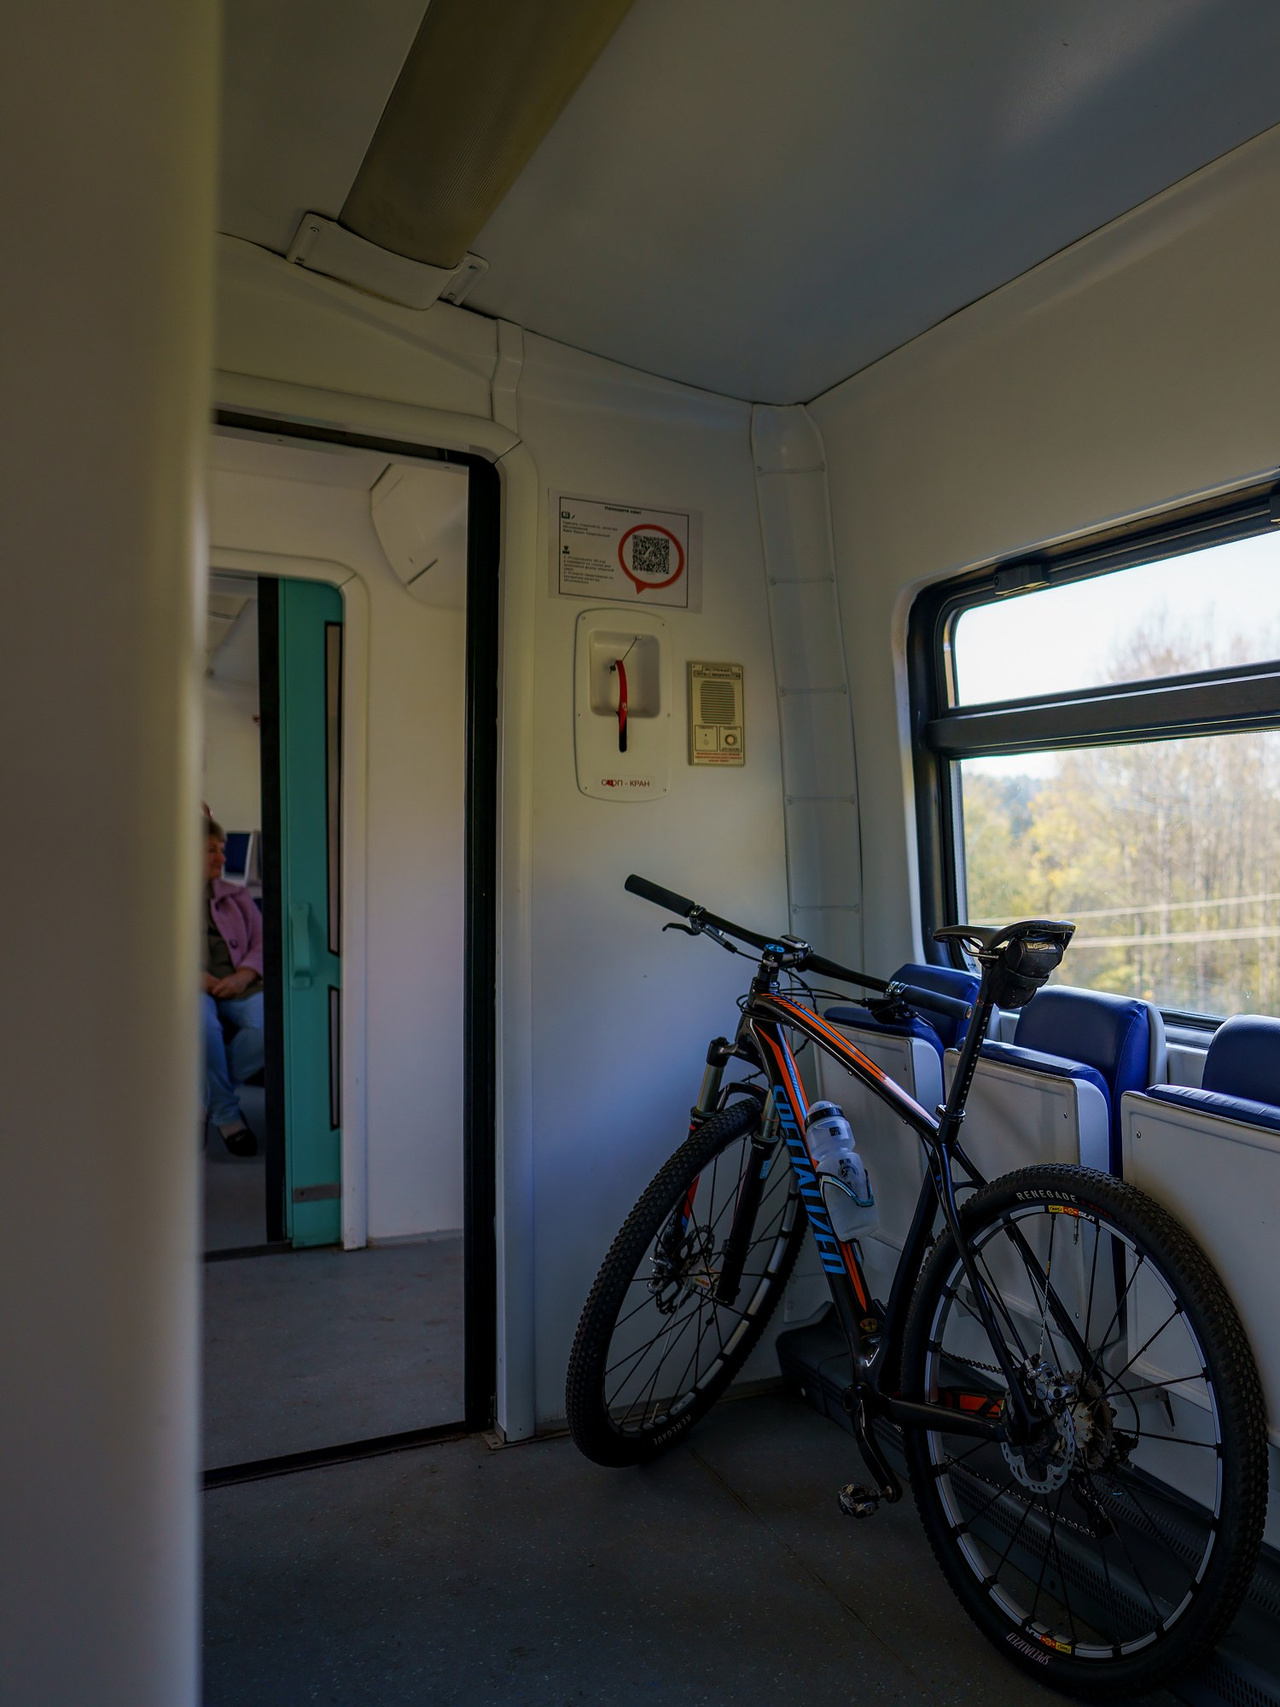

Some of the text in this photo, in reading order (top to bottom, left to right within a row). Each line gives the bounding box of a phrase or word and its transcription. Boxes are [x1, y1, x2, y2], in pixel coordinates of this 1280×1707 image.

[601, 778, 623, 787] СОП
[1016, 1189, 1078, 1203] RENEGADE
[1006, 1632, 1053, 1666] SPECIALIZED
